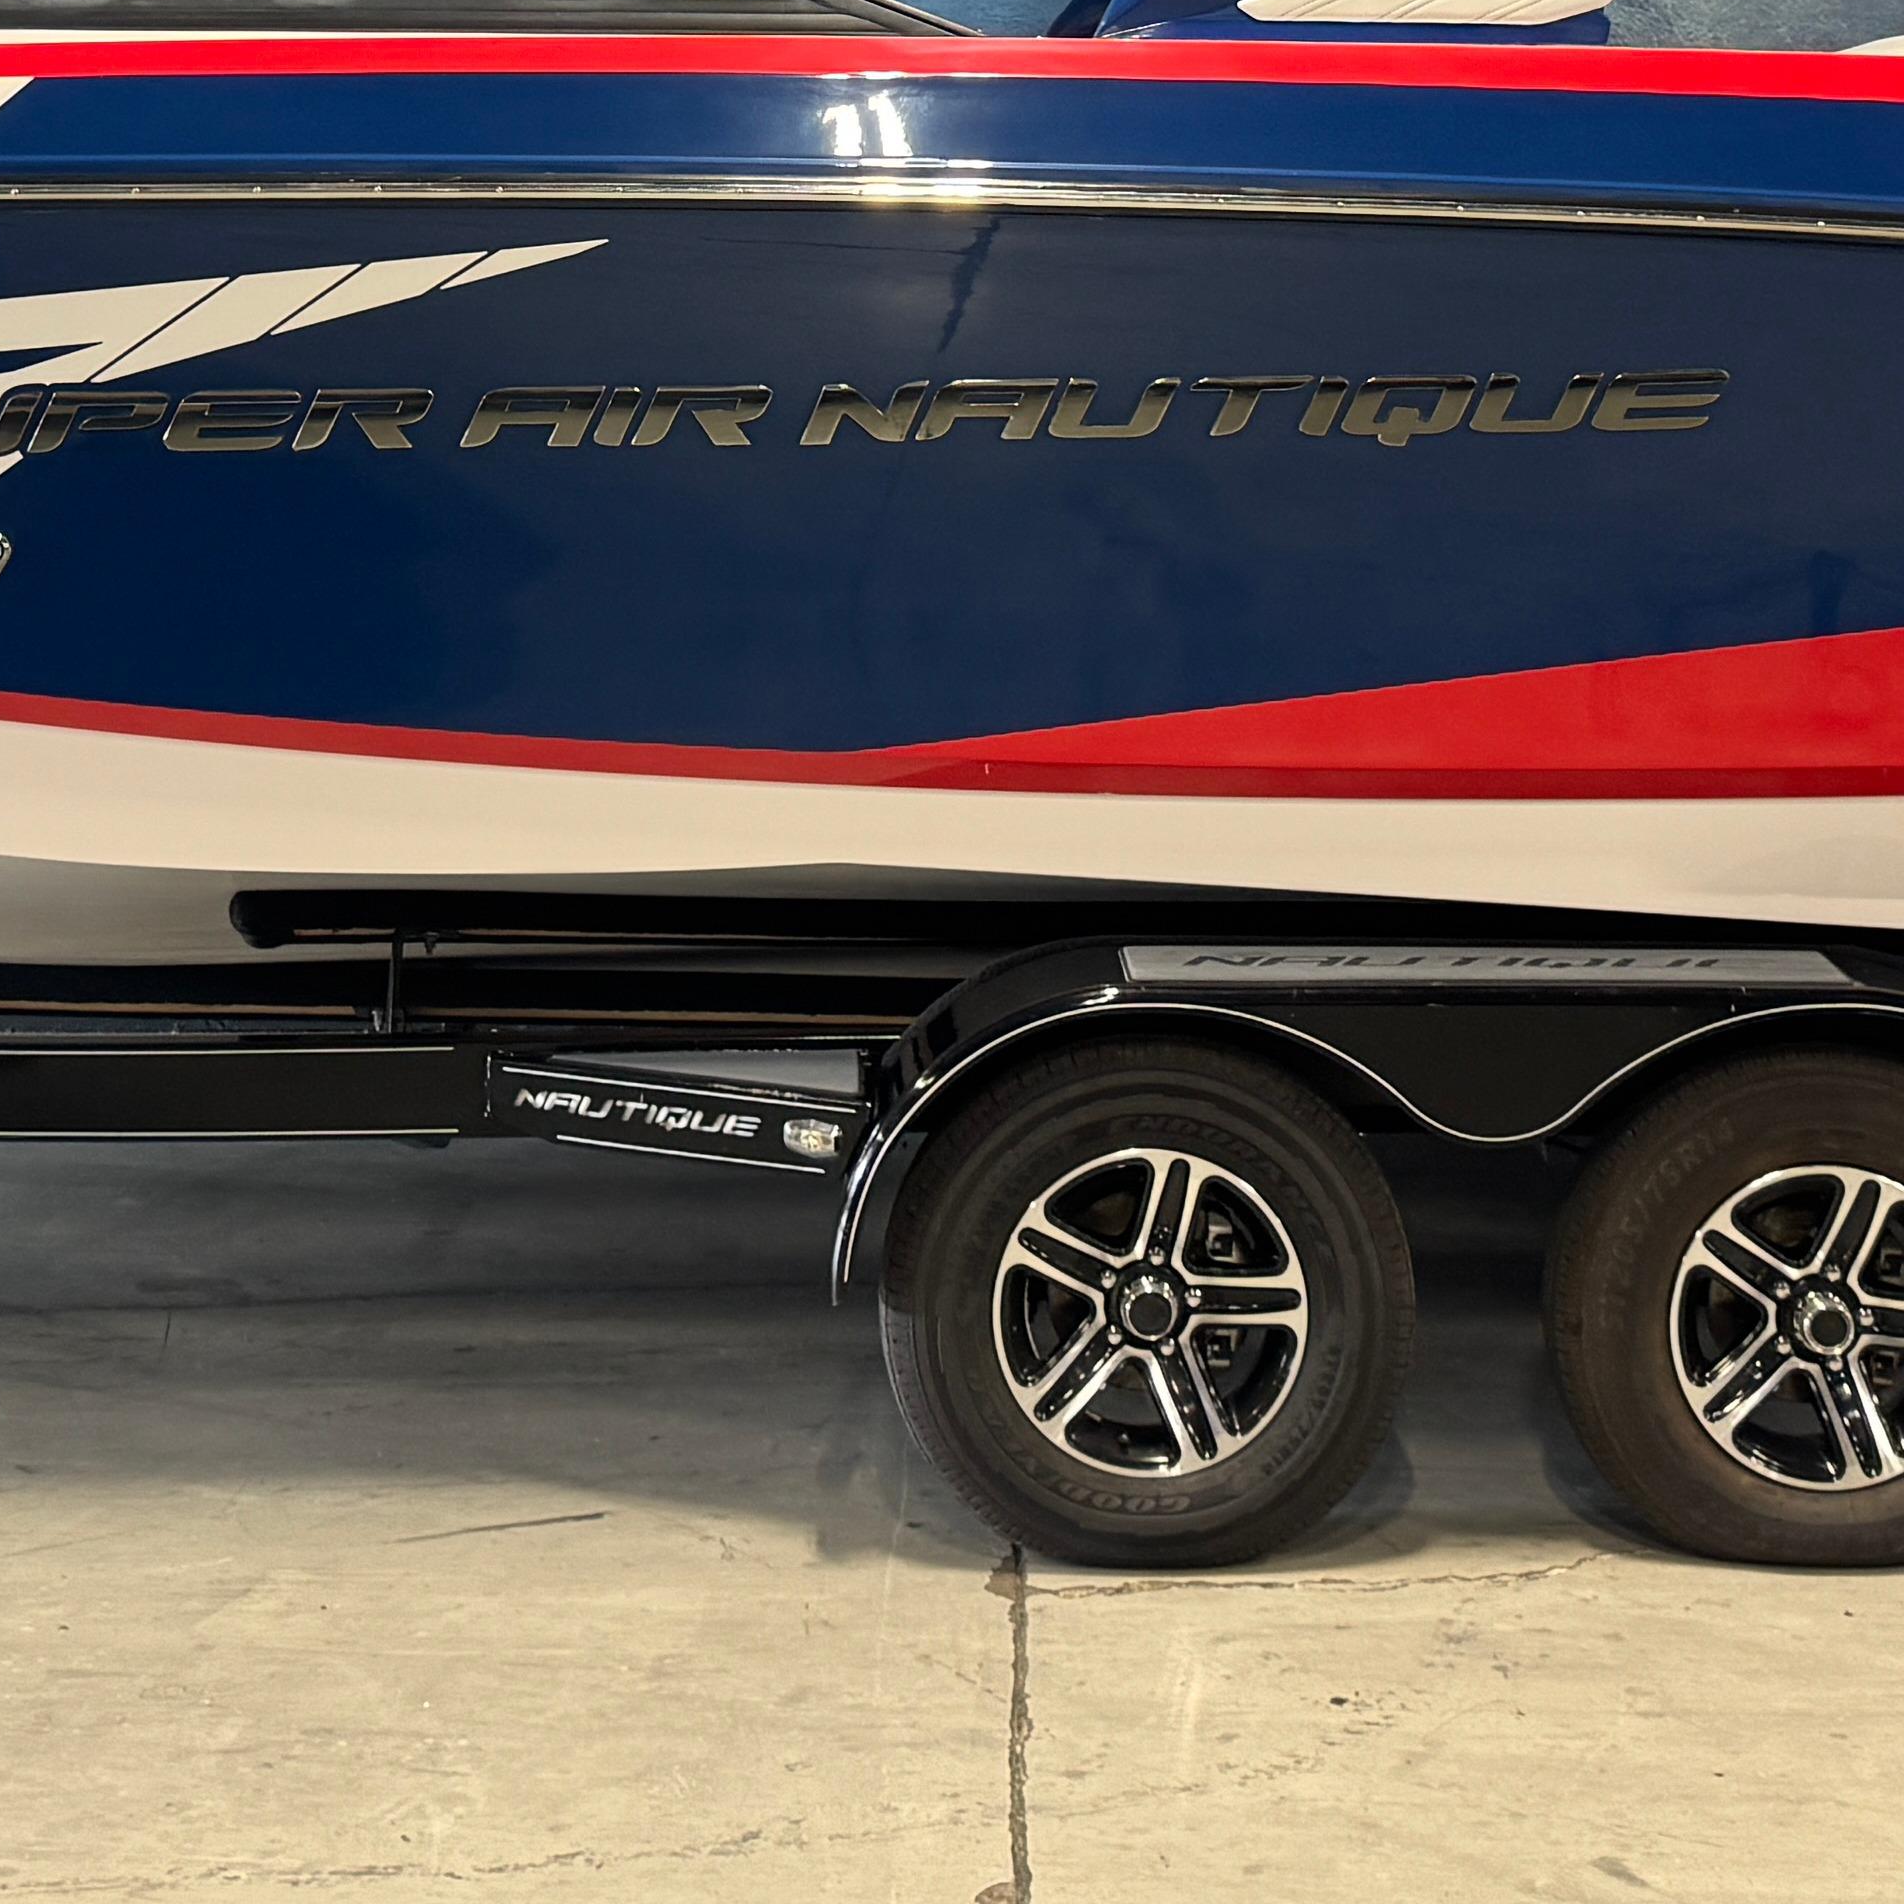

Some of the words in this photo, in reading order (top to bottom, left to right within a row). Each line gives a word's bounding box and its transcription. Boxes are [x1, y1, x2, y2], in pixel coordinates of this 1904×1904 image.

[459, 383, 773, 449] AIR
[800, 368, 1730, 447] NAUTIQUE
[513, 1088, 762, 1137] NAUTIQUE
